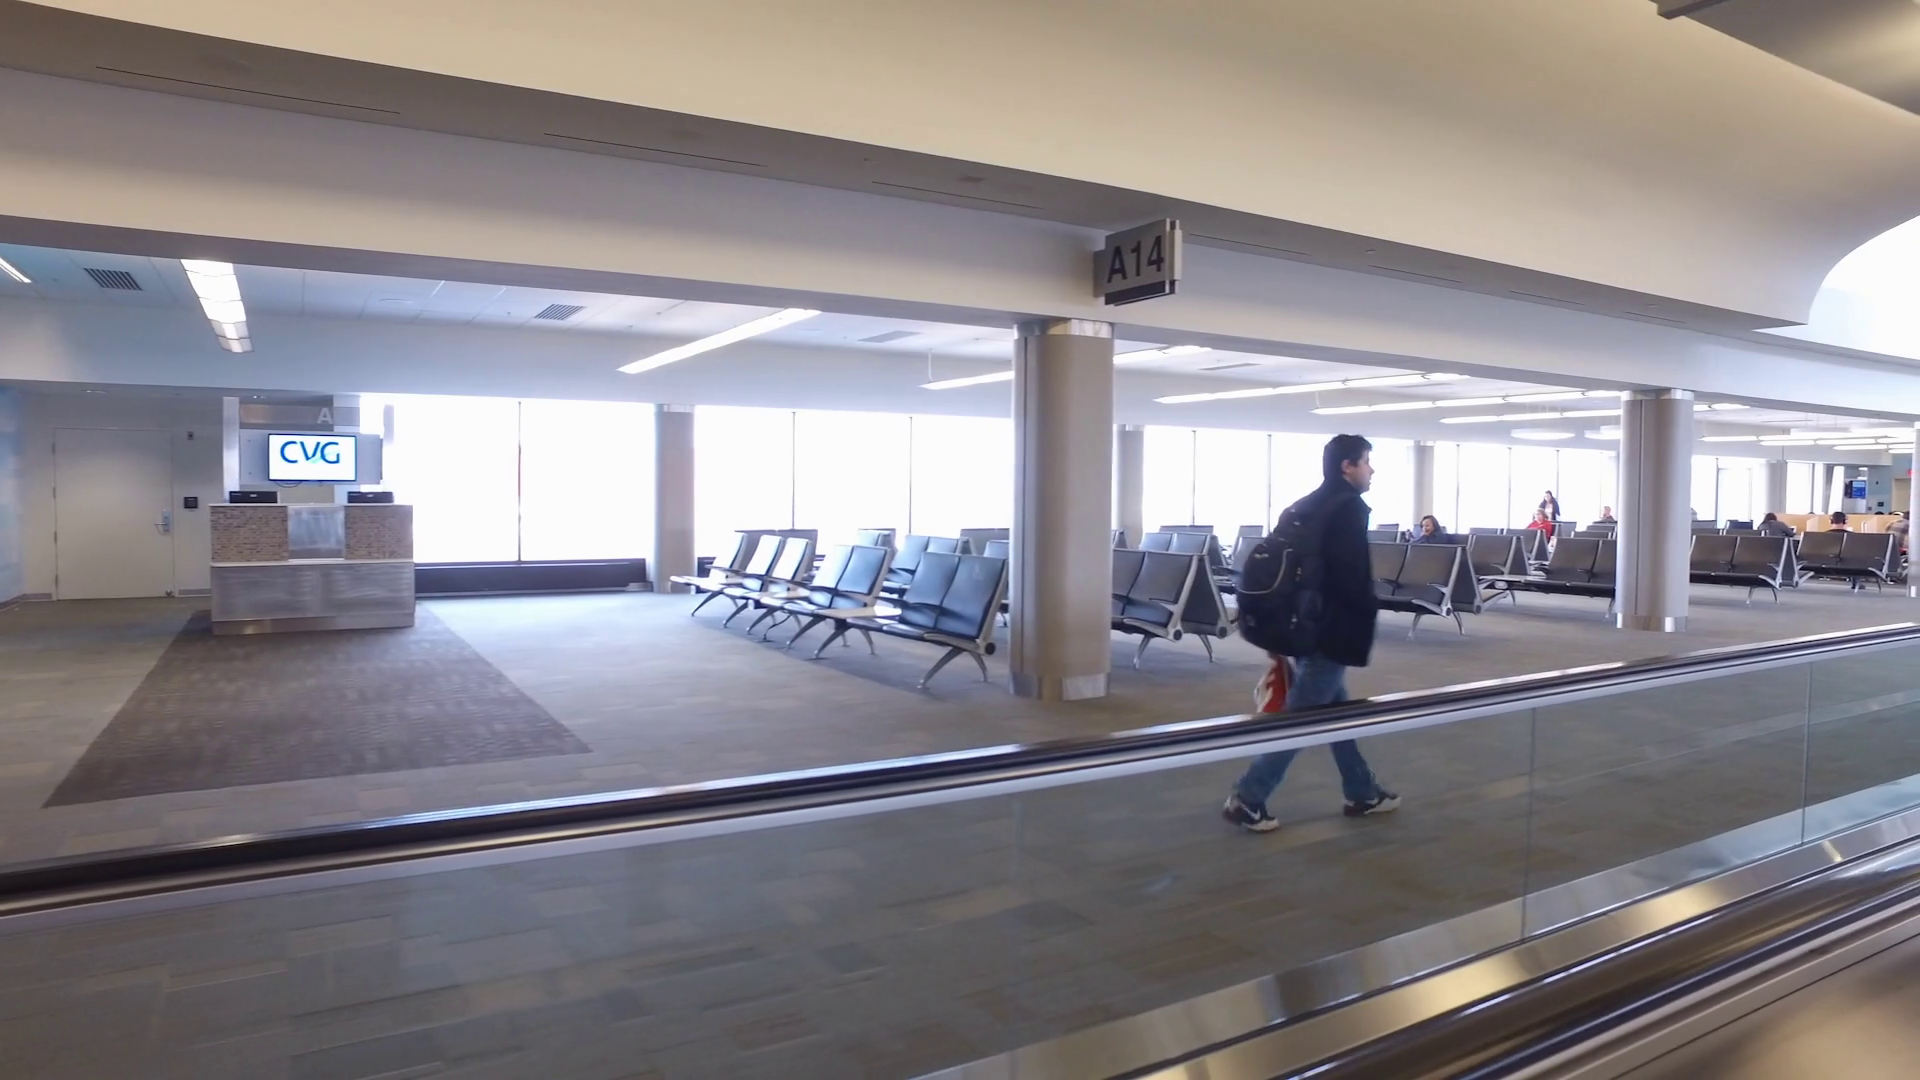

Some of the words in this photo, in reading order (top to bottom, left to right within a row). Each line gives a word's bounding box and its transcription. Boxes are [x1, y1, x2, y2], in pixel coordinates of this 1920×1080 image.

[1107, 235, 1164, 284] A14
[316, 407, 334, 425] A
[280, 440, 340, 464] CVG
